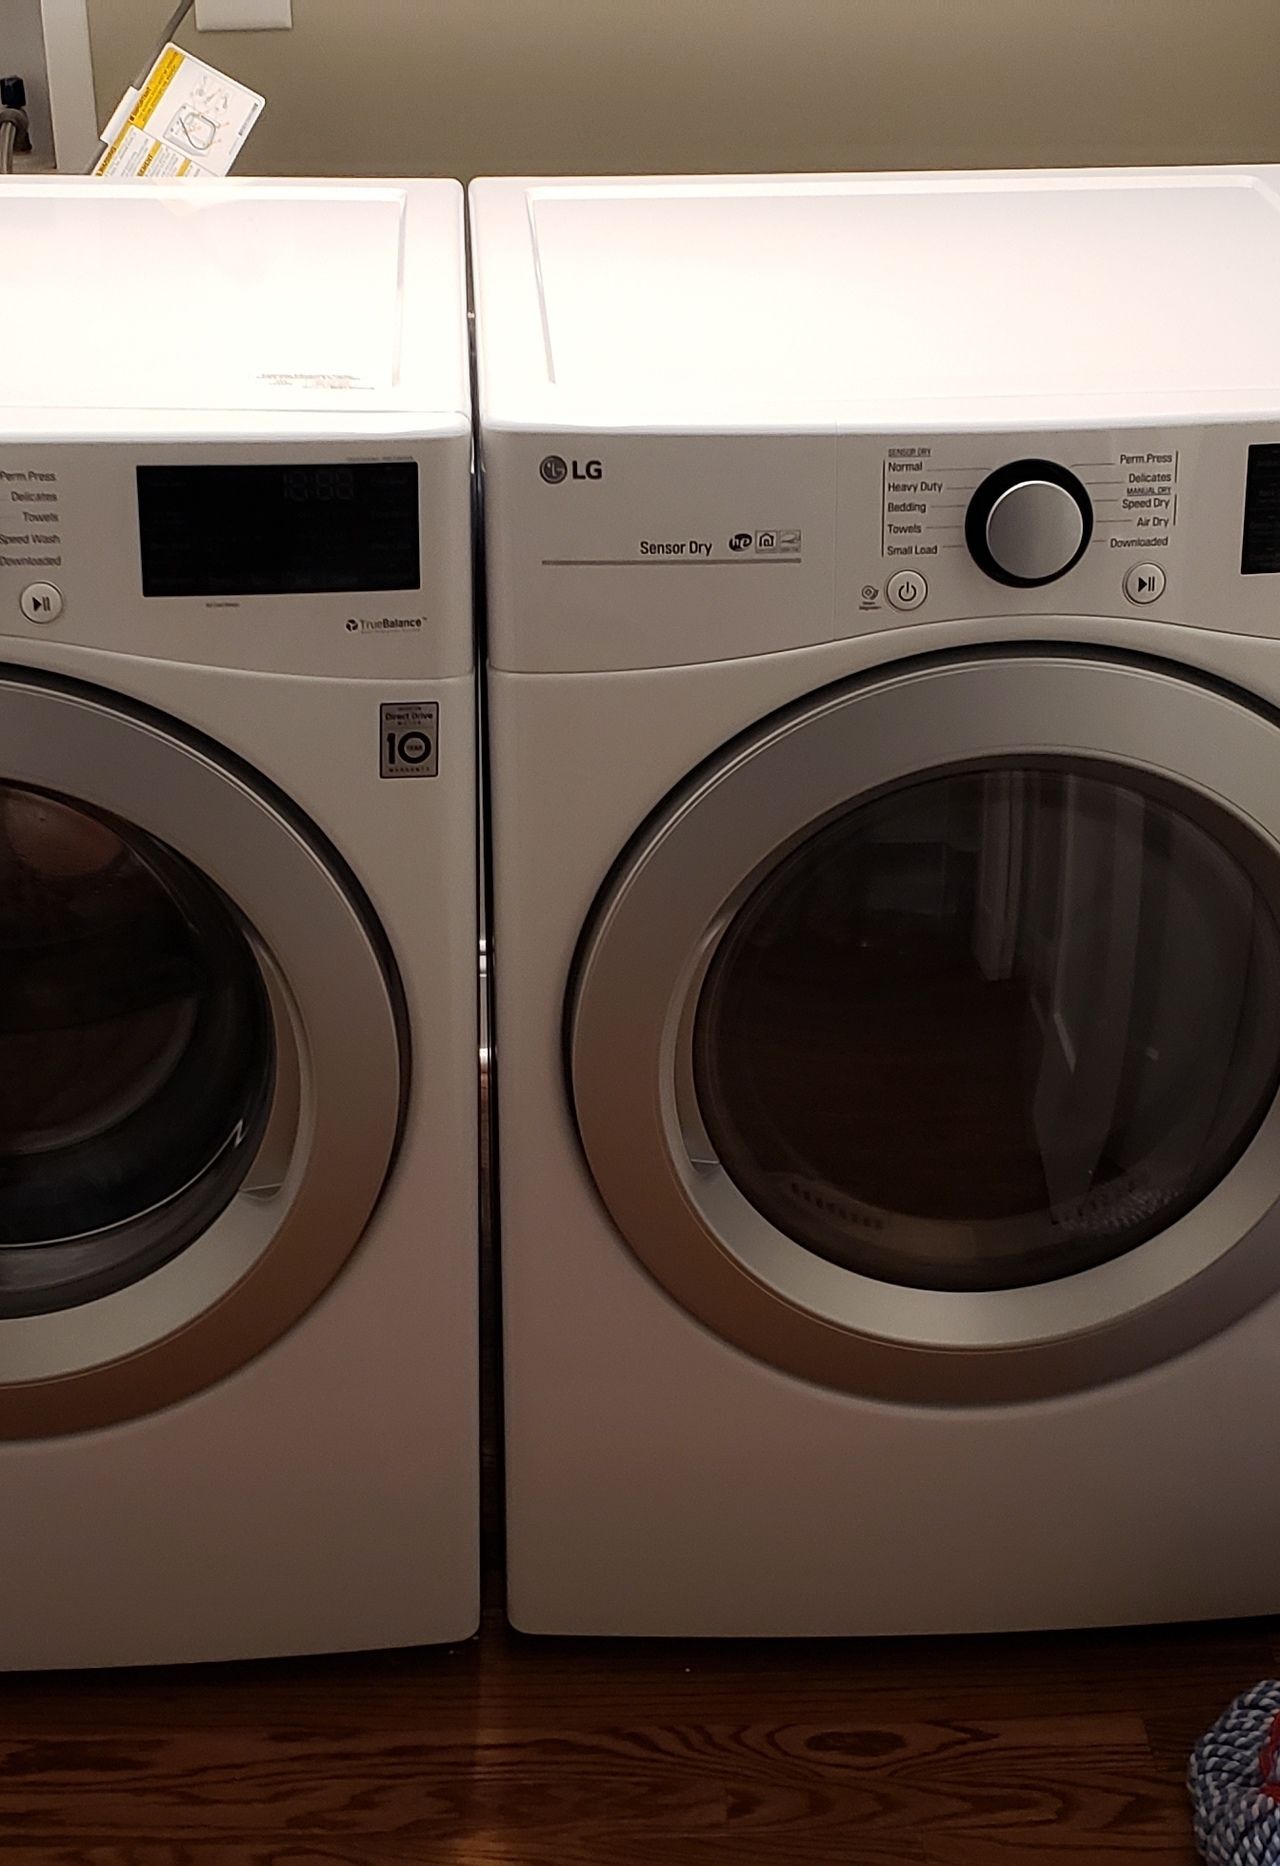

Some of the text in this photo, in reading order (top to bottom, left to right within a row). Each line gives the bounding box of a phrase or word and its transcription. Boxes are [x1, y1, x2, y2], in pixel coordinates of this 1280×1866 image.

[572, 460, 602, 480] LG
[888, 461, 923, 472] Normal
[28, 470, 56, 481] Press
[1129, 472, 1172, 483] Delicates
[888, 481, 943, 493] Heavy Duty
[11, 491, 57, 502] Delicates
[887, 502, 927, 514] Bedding
[1122, 497, 1170, 510] Speed Dry
[23, 511, 59, 522] Towels
[1137, 516, 1169, 528] Air Dry
[887, 523, 922, 534] Towels
[31, 534, 60, 544] Wash
[1110, 535, 1169, 549] Downloaded
[640, 540, 713, 557] Sensor Dry
[887, 544, 938, 556] Small Load
[0, 555, 62, 567] Downloaded
[385, 711, 433, 721] Direct Drive
[386, 731, 432, 765] 10
